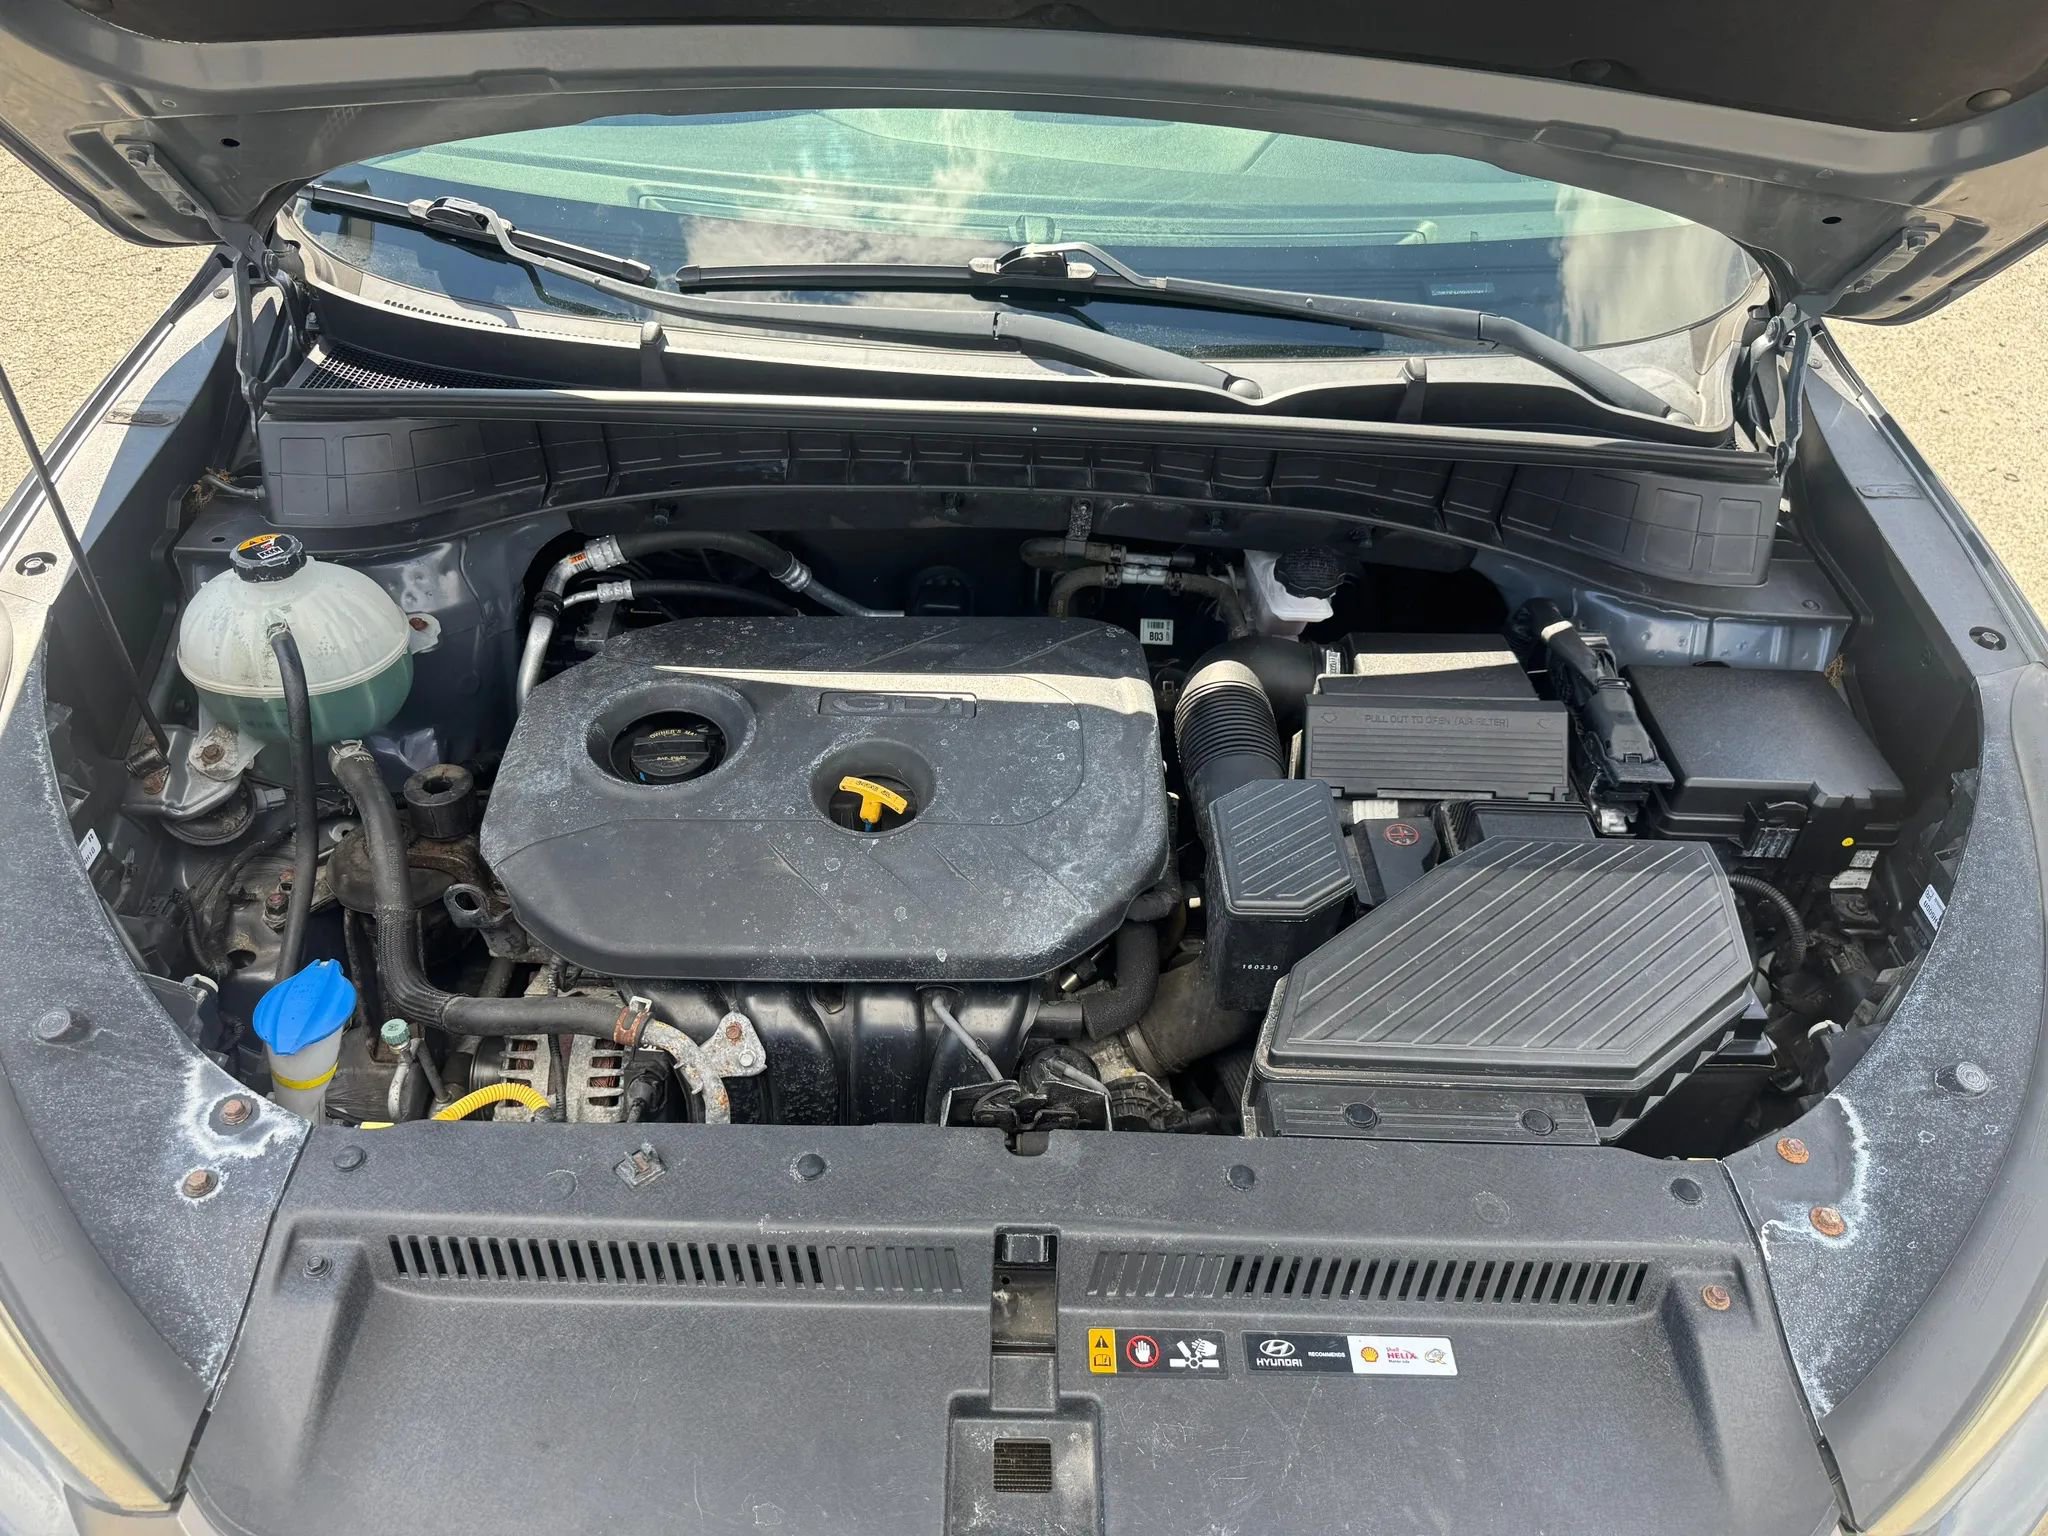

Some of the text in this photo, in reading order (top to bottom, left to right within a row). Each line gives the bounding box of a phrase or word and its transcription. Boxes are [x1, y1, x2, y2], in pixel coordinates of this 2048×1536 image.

[1149, 631, 1164, 641] B03
[1364, 714, 1389, 724] PULL
[1390, 714, 1409, 725] OUT
[1411, 715, 1424, 725] TO
[1307, 1351, 1346, 1359] RECOMMENDS
[1386, 1352, 1418, 1361] HELIX
[1256, 1357, 1303, 1368] HYUNDAI
